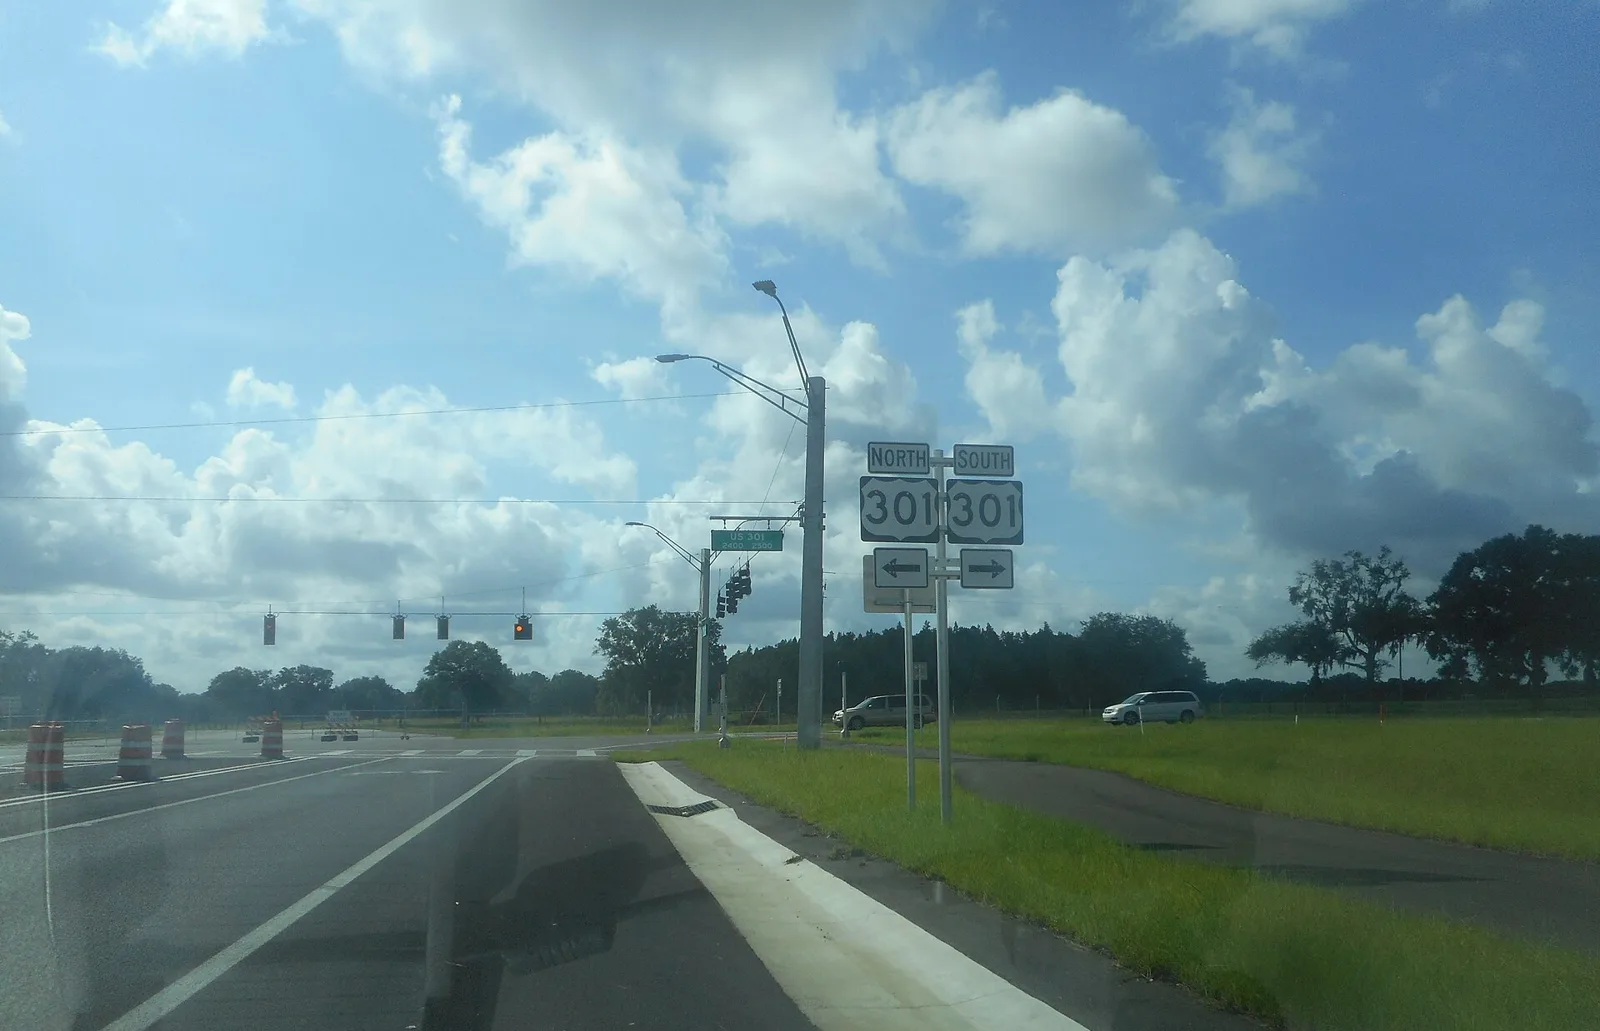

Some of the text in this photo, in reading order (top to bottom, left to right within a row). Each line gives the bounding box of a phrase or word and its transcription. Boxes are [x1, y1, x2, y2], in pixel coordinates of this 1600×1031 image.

[871, 447, 926, 468] NORTH
[957, 449, 1011, 470] SOUTH
[865, 489, 932, 526] 301
[952, 492, 1016, 528] 301
[730, 533, 765, 541] US 301
